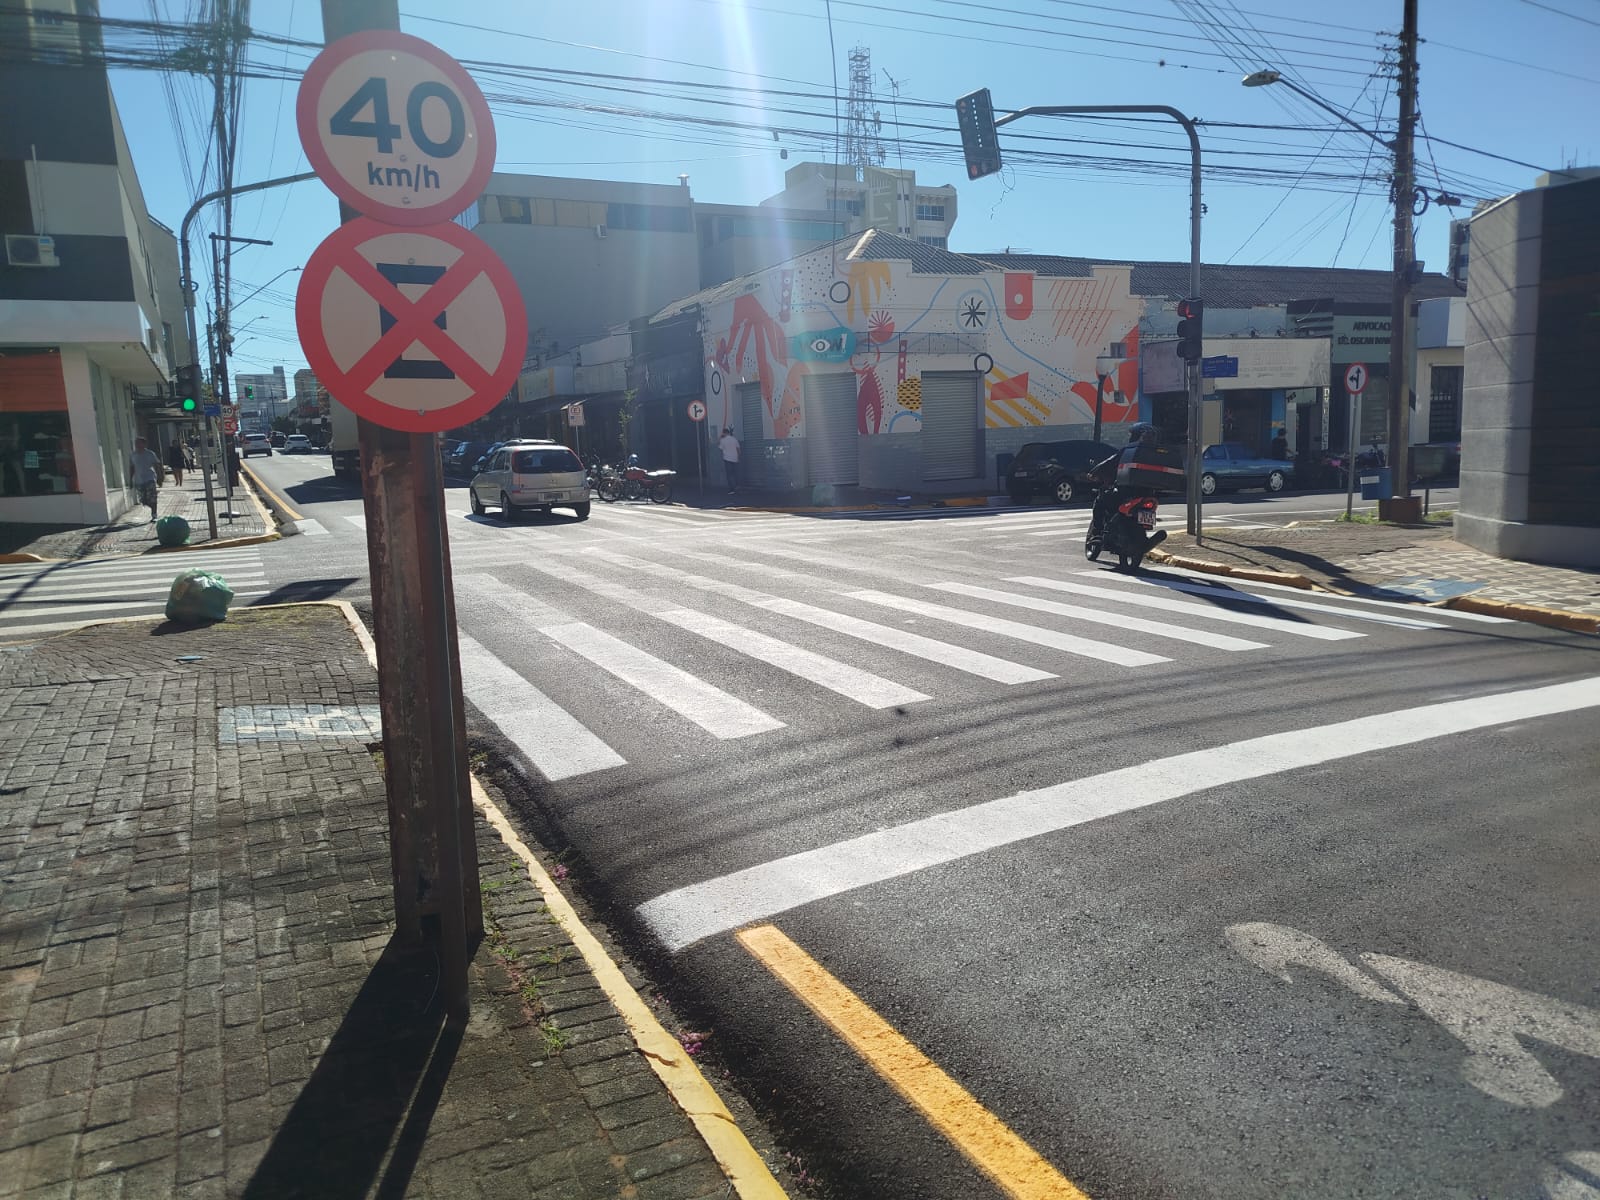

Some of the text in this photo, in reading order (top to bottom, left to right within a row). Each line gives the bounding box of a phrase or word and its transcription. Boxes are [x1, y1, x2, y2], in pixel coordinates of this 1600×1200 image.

[330, 77, 466, 158] 40
[367, 161, 440, 192] km/h
[1353, 321, 1391, 331] ADVOCACI
